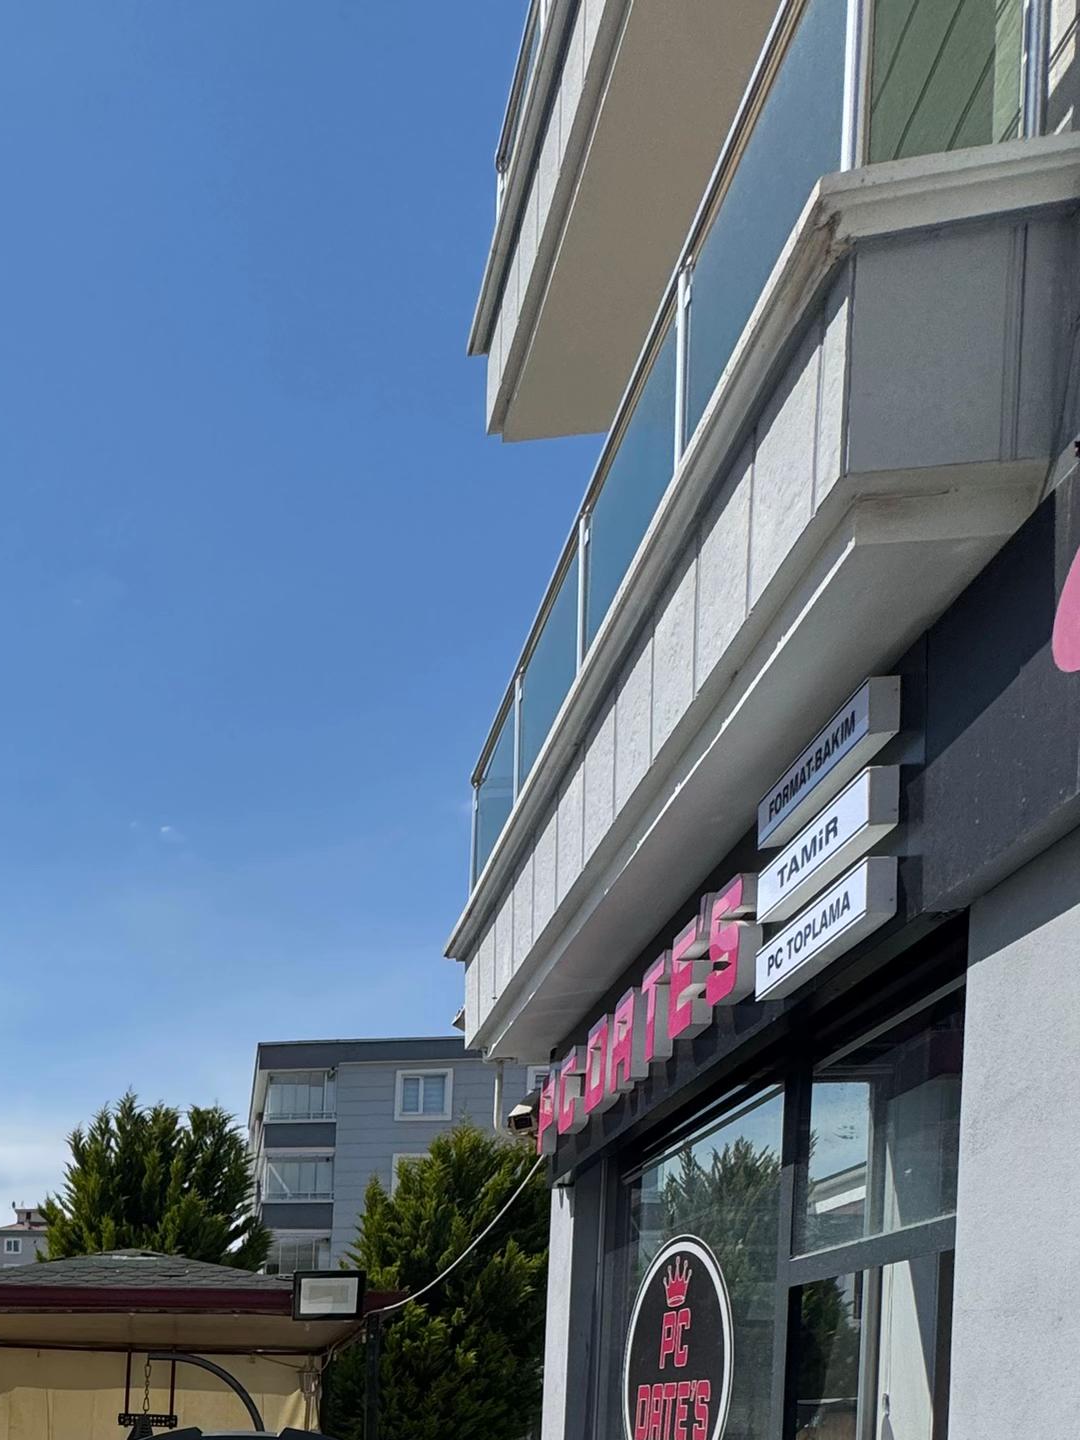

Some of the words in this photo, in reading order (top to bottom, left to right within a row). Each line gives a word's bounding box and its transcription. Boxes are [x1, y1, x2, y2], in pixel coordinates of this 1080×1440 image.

[768, 710, 856, 822] FORMAT-BAKIM
[767, 947, 784, 977] PC
[786, 891, 851, 960] TOPLAMA
[659, 1308, 691, 1369] PC
